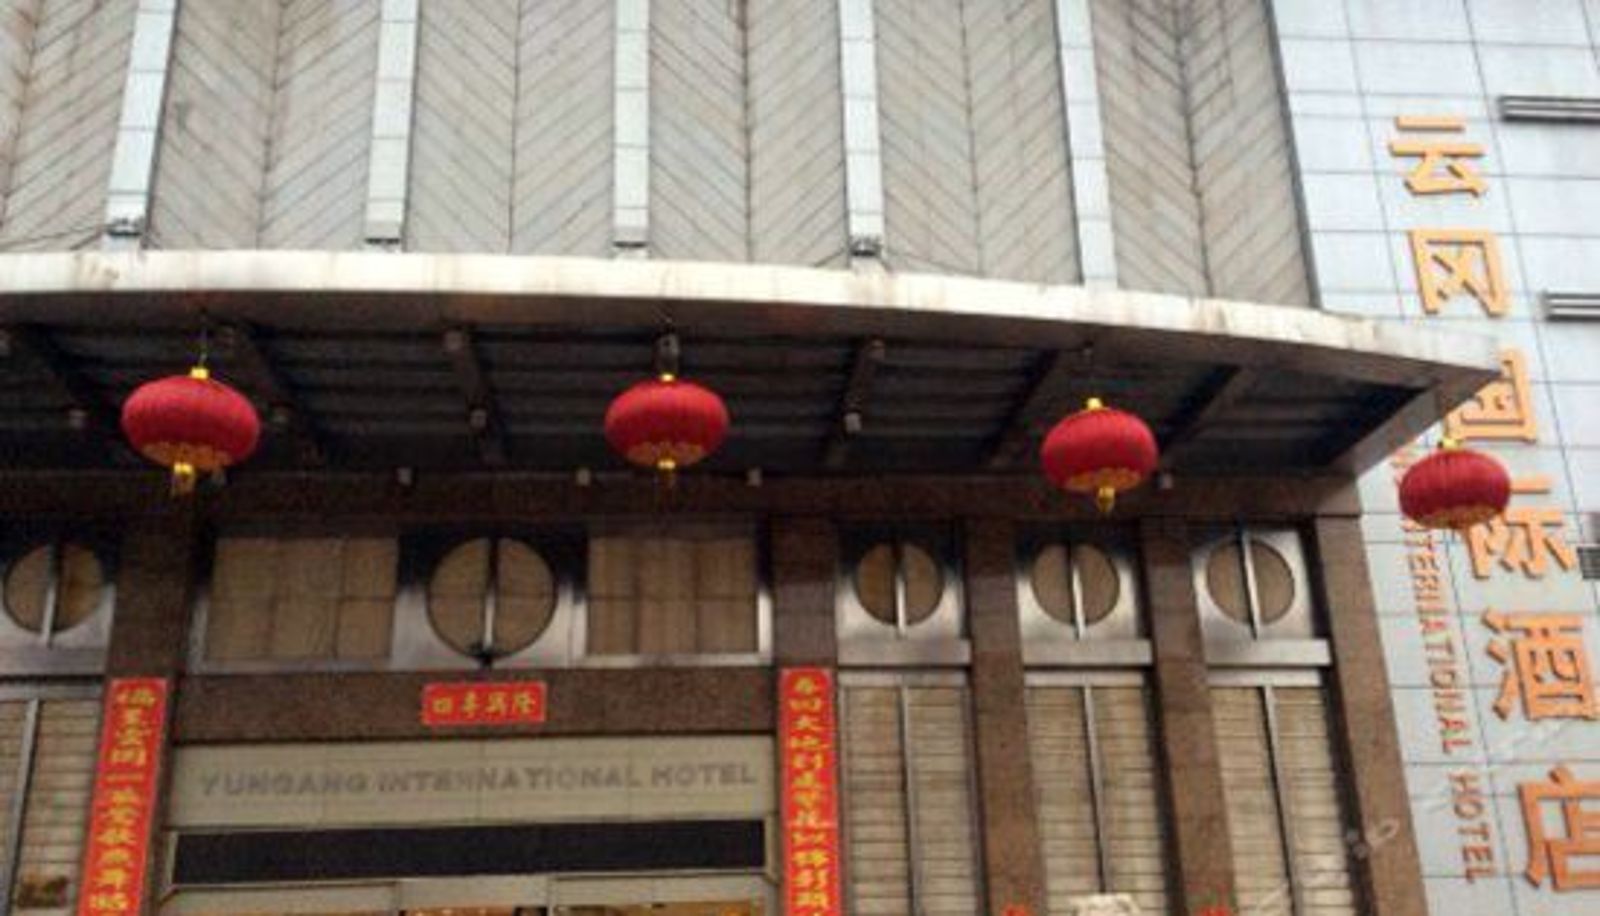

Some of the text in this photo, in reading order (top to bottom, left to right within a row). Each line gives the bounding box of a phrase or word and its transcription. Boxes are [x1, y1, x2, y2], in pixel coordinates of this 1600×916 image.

[202, 762, 757, 797] YUNGANG INTERNATIONAL HOTEL
[1449, 771, 1497, 884] HOTEL
